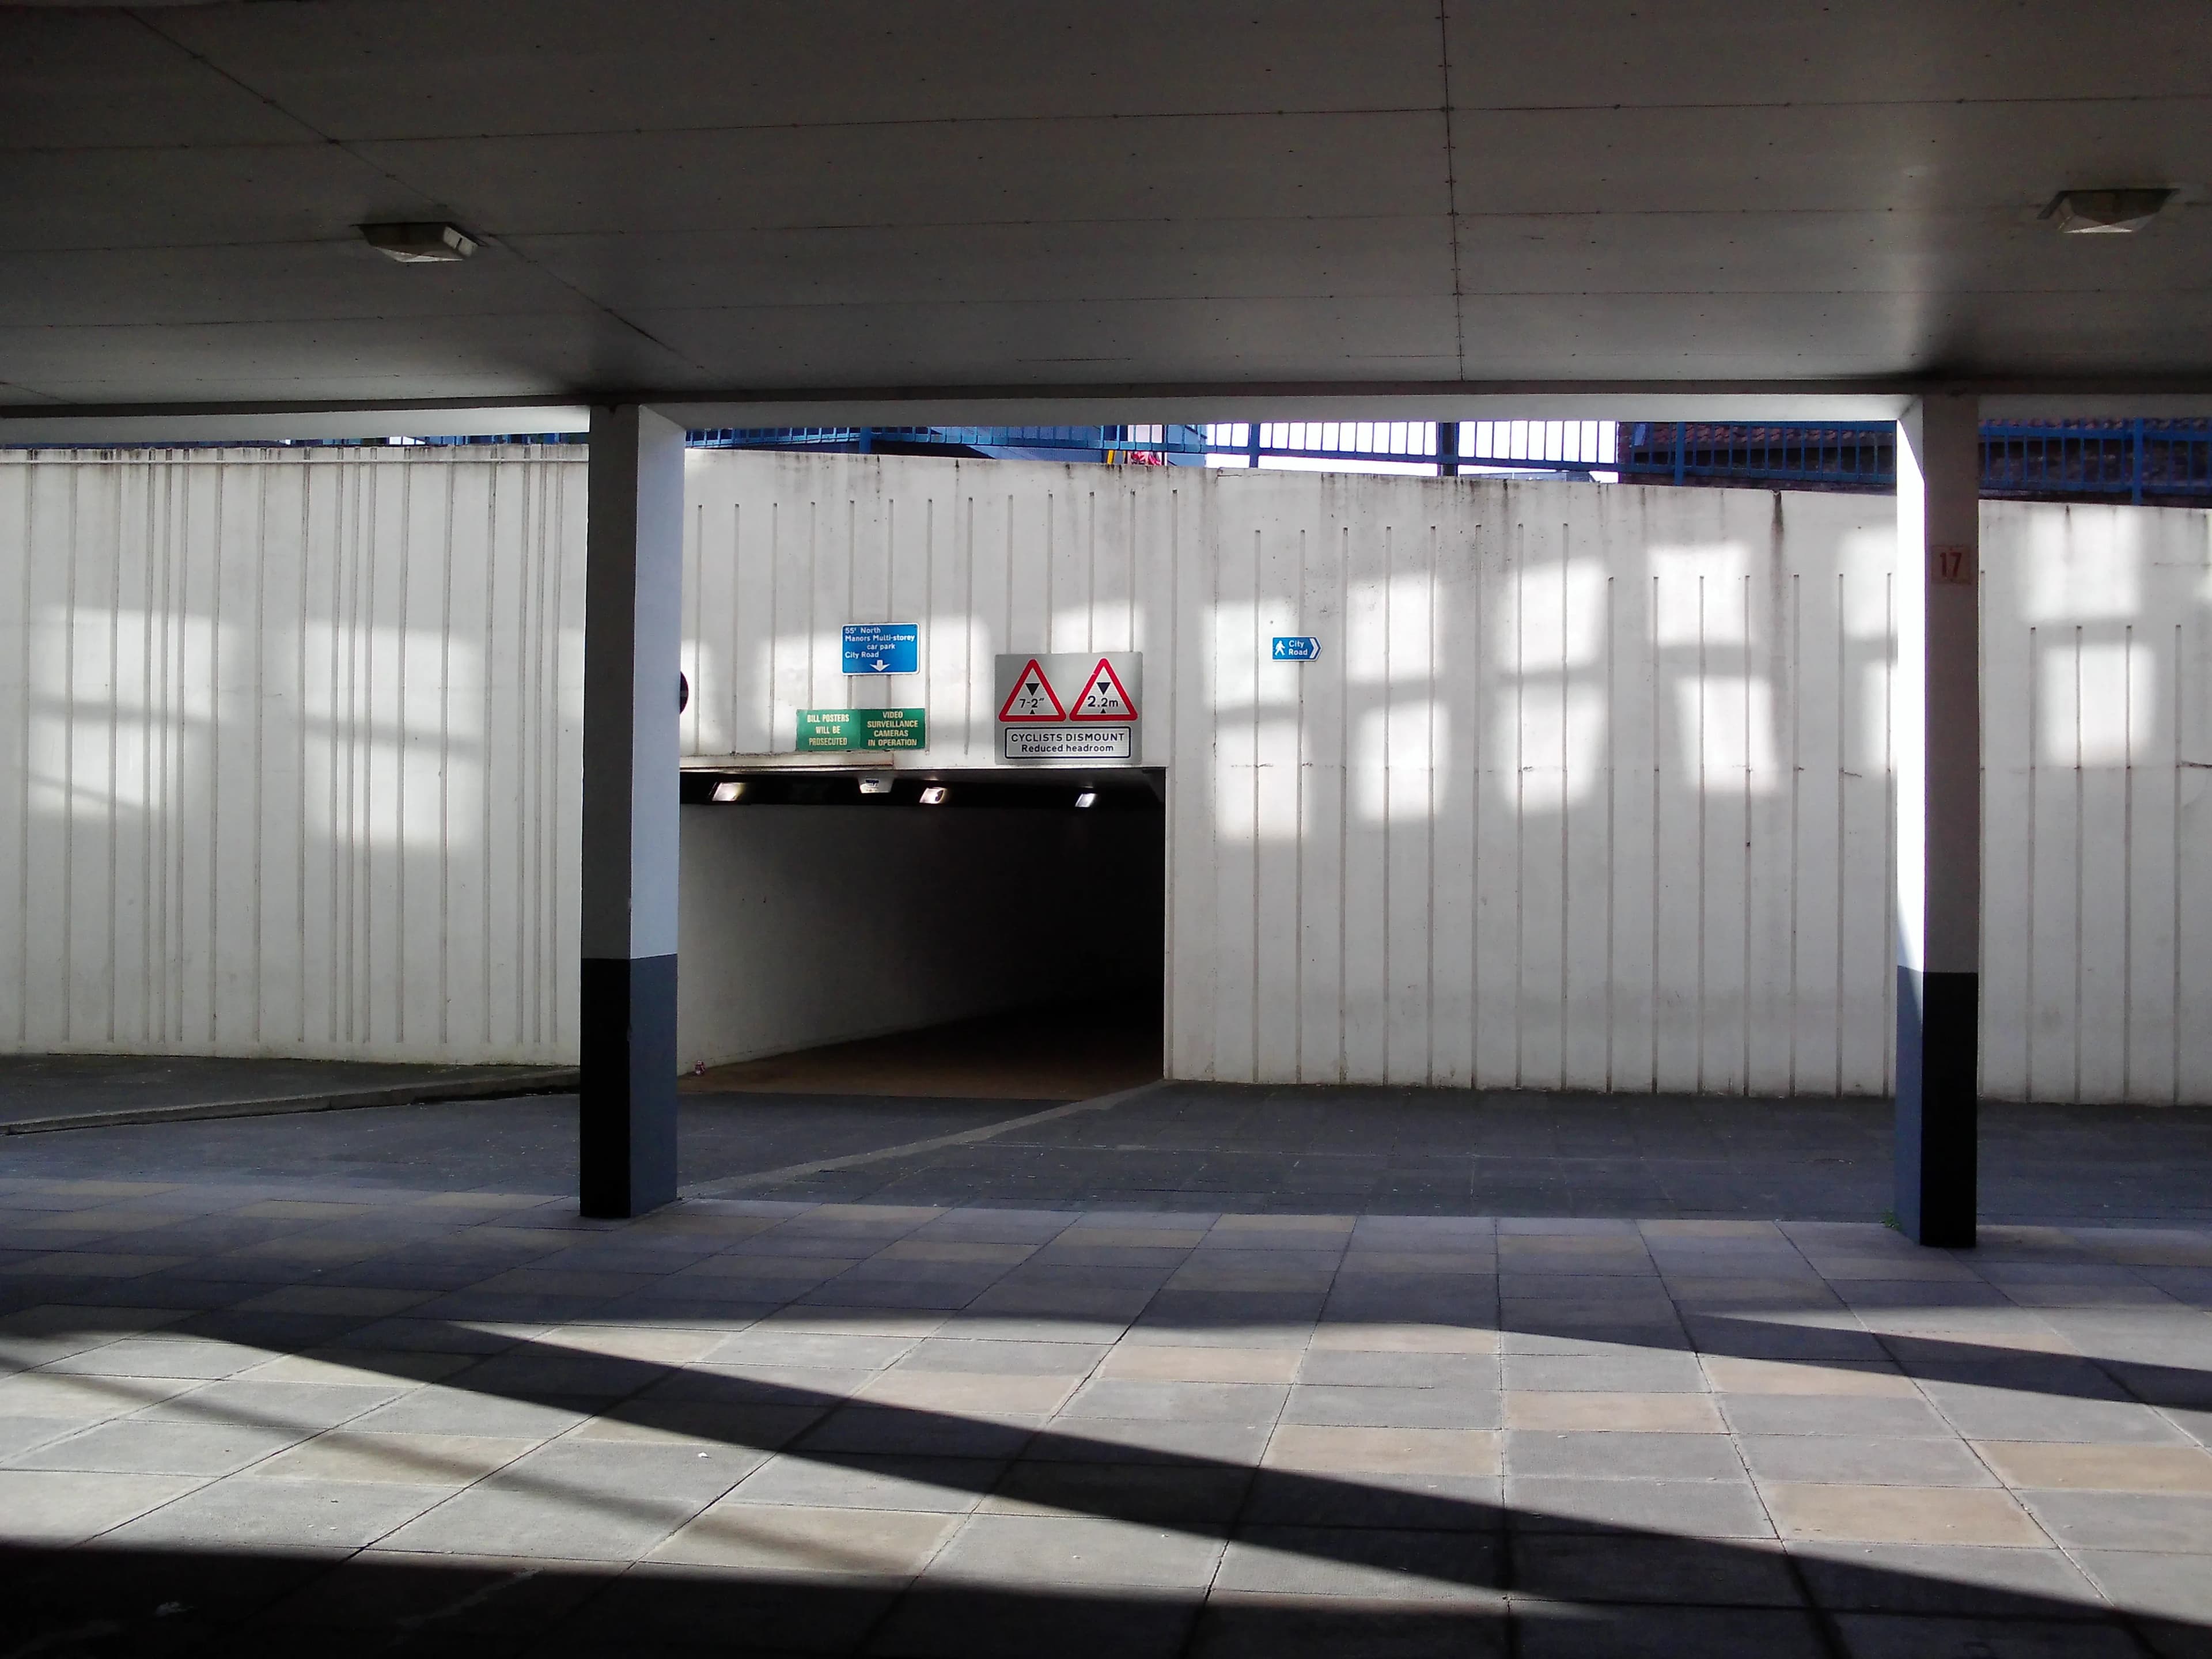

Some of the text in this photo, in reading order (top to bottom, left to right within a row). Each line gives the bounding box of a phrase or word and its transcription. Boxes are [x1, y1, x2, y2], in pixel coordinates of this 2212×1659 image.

[1940, 552, 1962, 577] 17
[1289, 640, 1305, 648] City
[1087, 696, 1119, 707] 2.2m
[807, 714, 820, 722] BILL
[832, 726, 841, 734] BE
[809, 737, 847, 745] PROSECUTED
[1011, 734, 1062, 742] CYCLISTS
[1021, 744, 1113, 752] Reduced headroom
